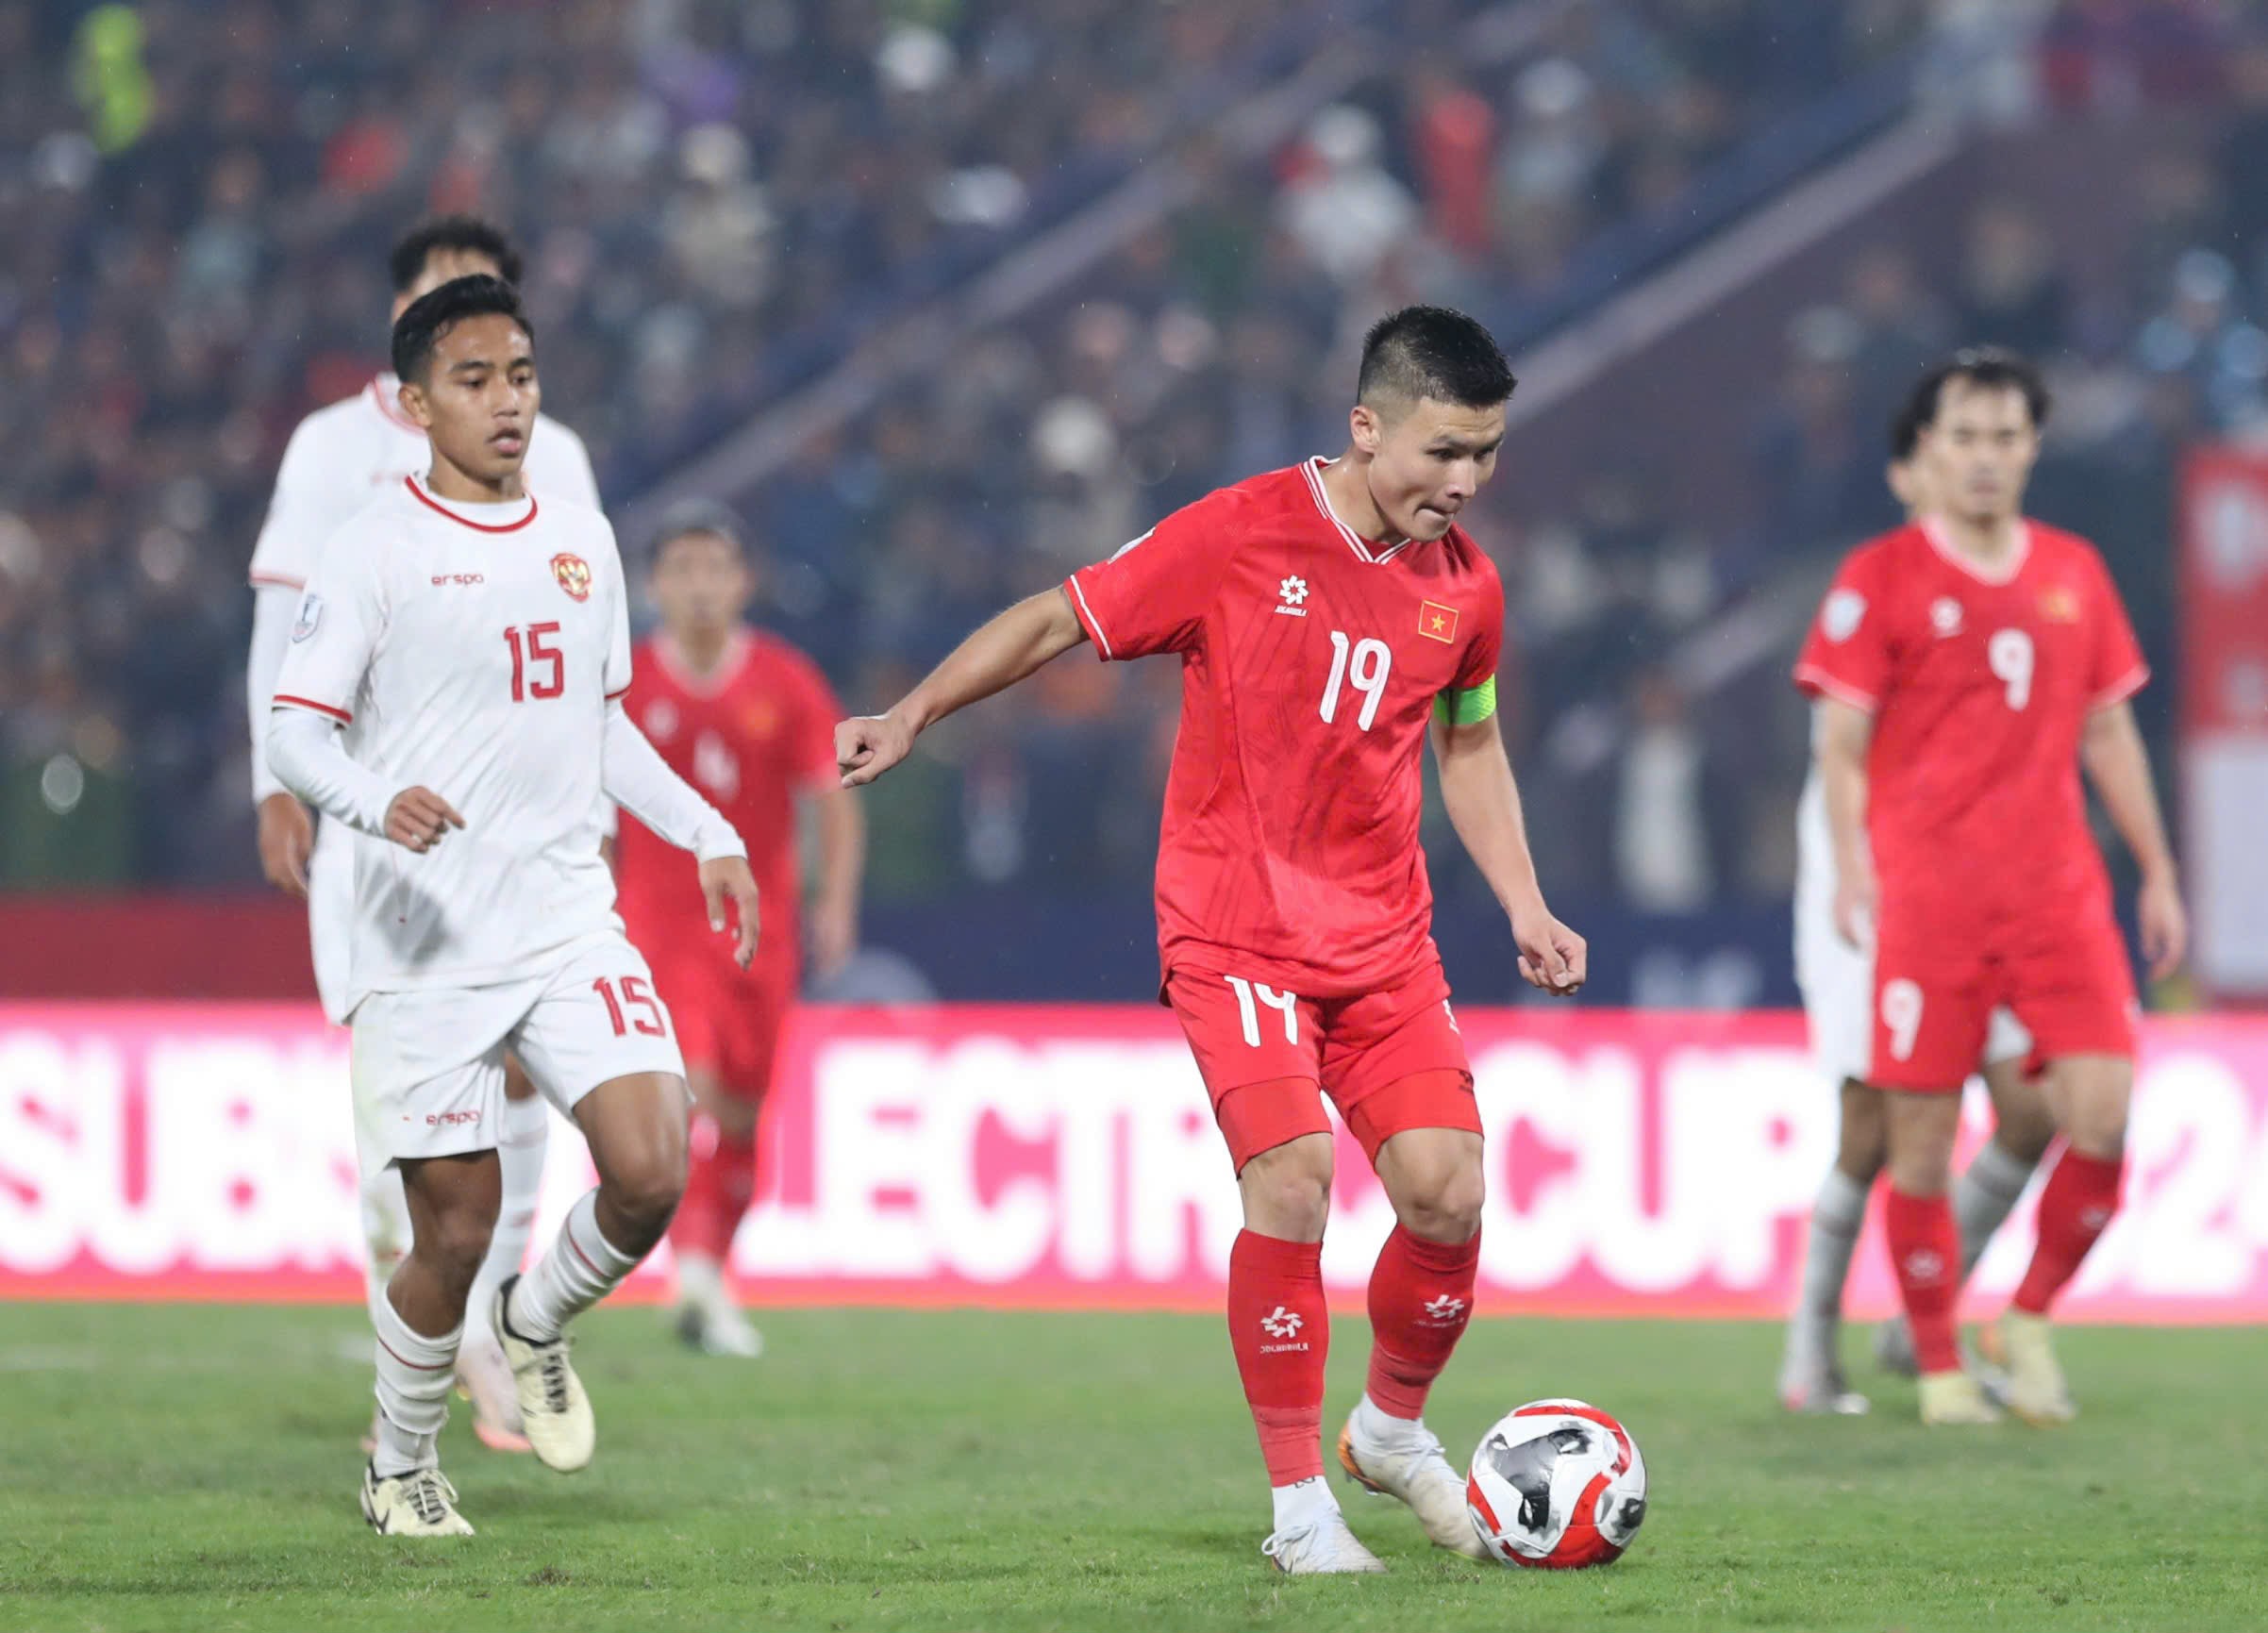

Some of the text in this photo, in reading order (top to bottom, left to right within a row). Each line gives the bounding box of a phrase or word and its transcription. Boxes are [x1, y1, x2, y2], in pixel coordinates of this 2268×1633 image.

[431, 573, 484, 588] erspo
[504, 621, 564, 702] 15
[1319, 629, 1392, 732] 19
[1988, 626, 2034, 711] 9
[592, 975, 667, 1039] 15
[1881, 978, 1925, 1061] 9
[1475, 1041, 1842, 1291] CUP
